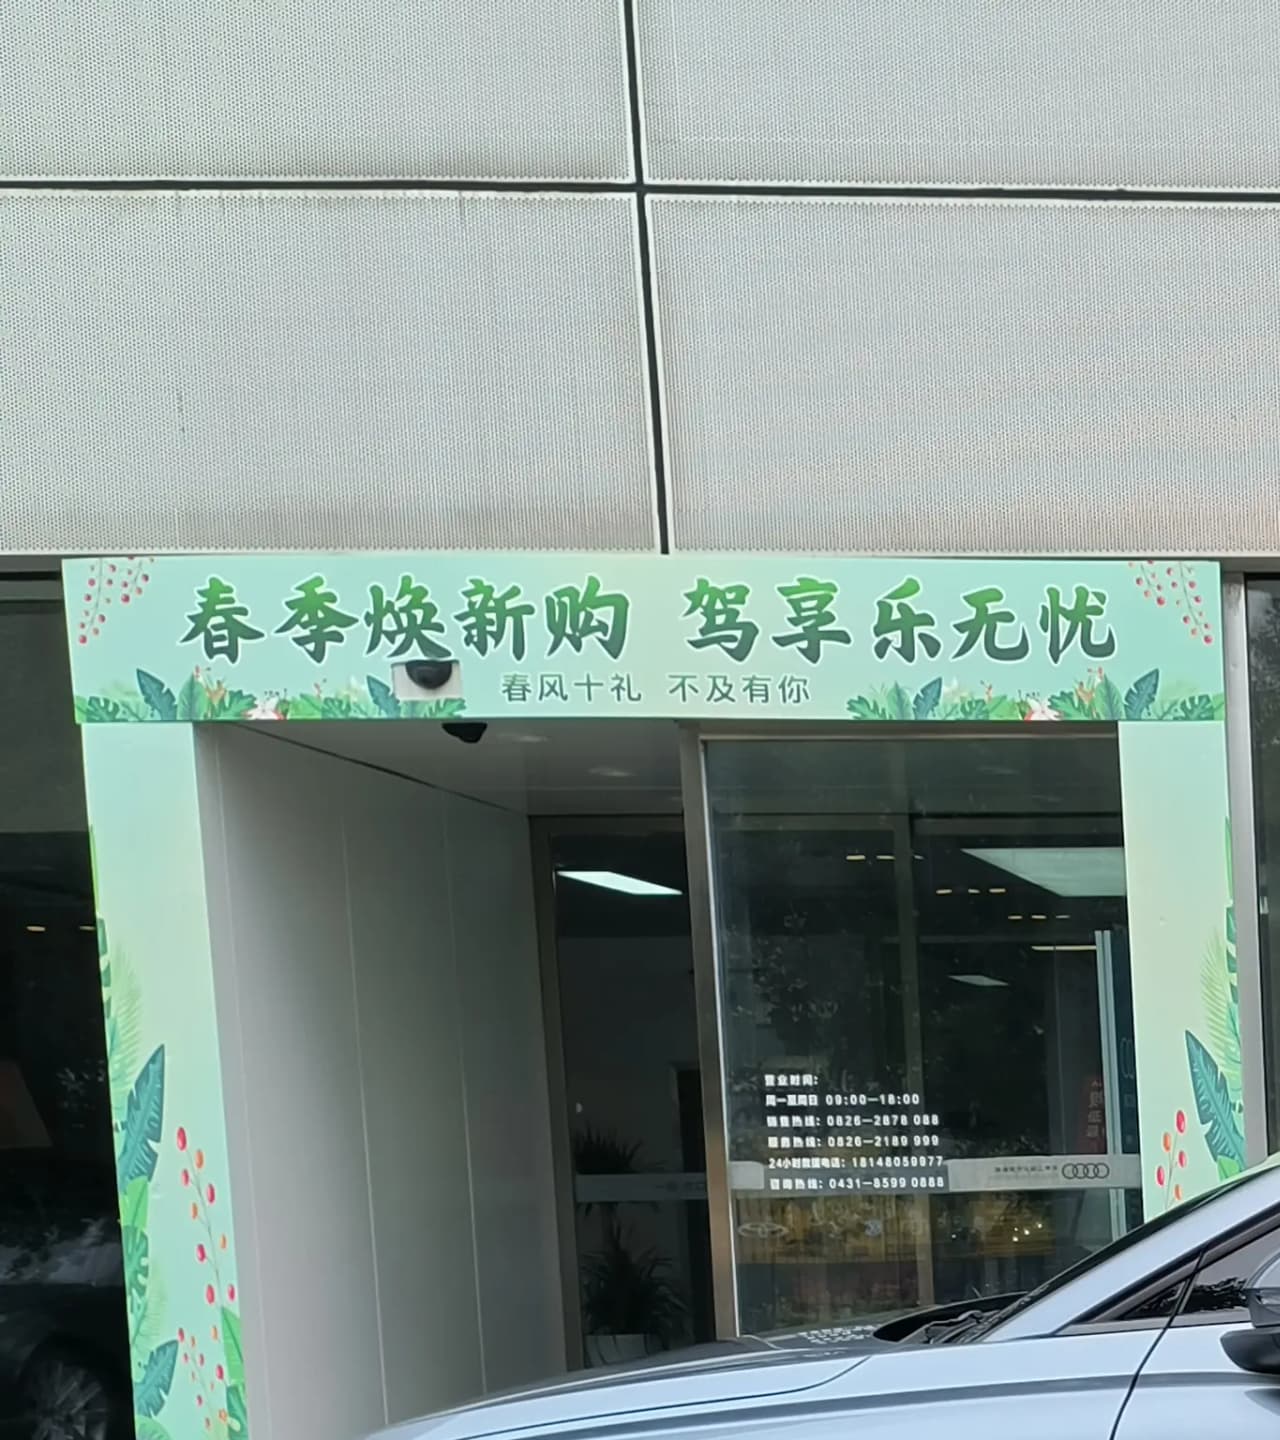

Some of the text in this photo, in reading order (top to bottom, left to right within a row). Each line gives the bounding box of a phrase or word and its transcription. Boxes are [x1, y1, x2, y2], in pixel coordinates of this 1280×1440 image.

[179, 574, 1118, 665] 春季焕新购 驾享乐无忧
[501, 673, 810, 704] 春风十礼 不及有你
